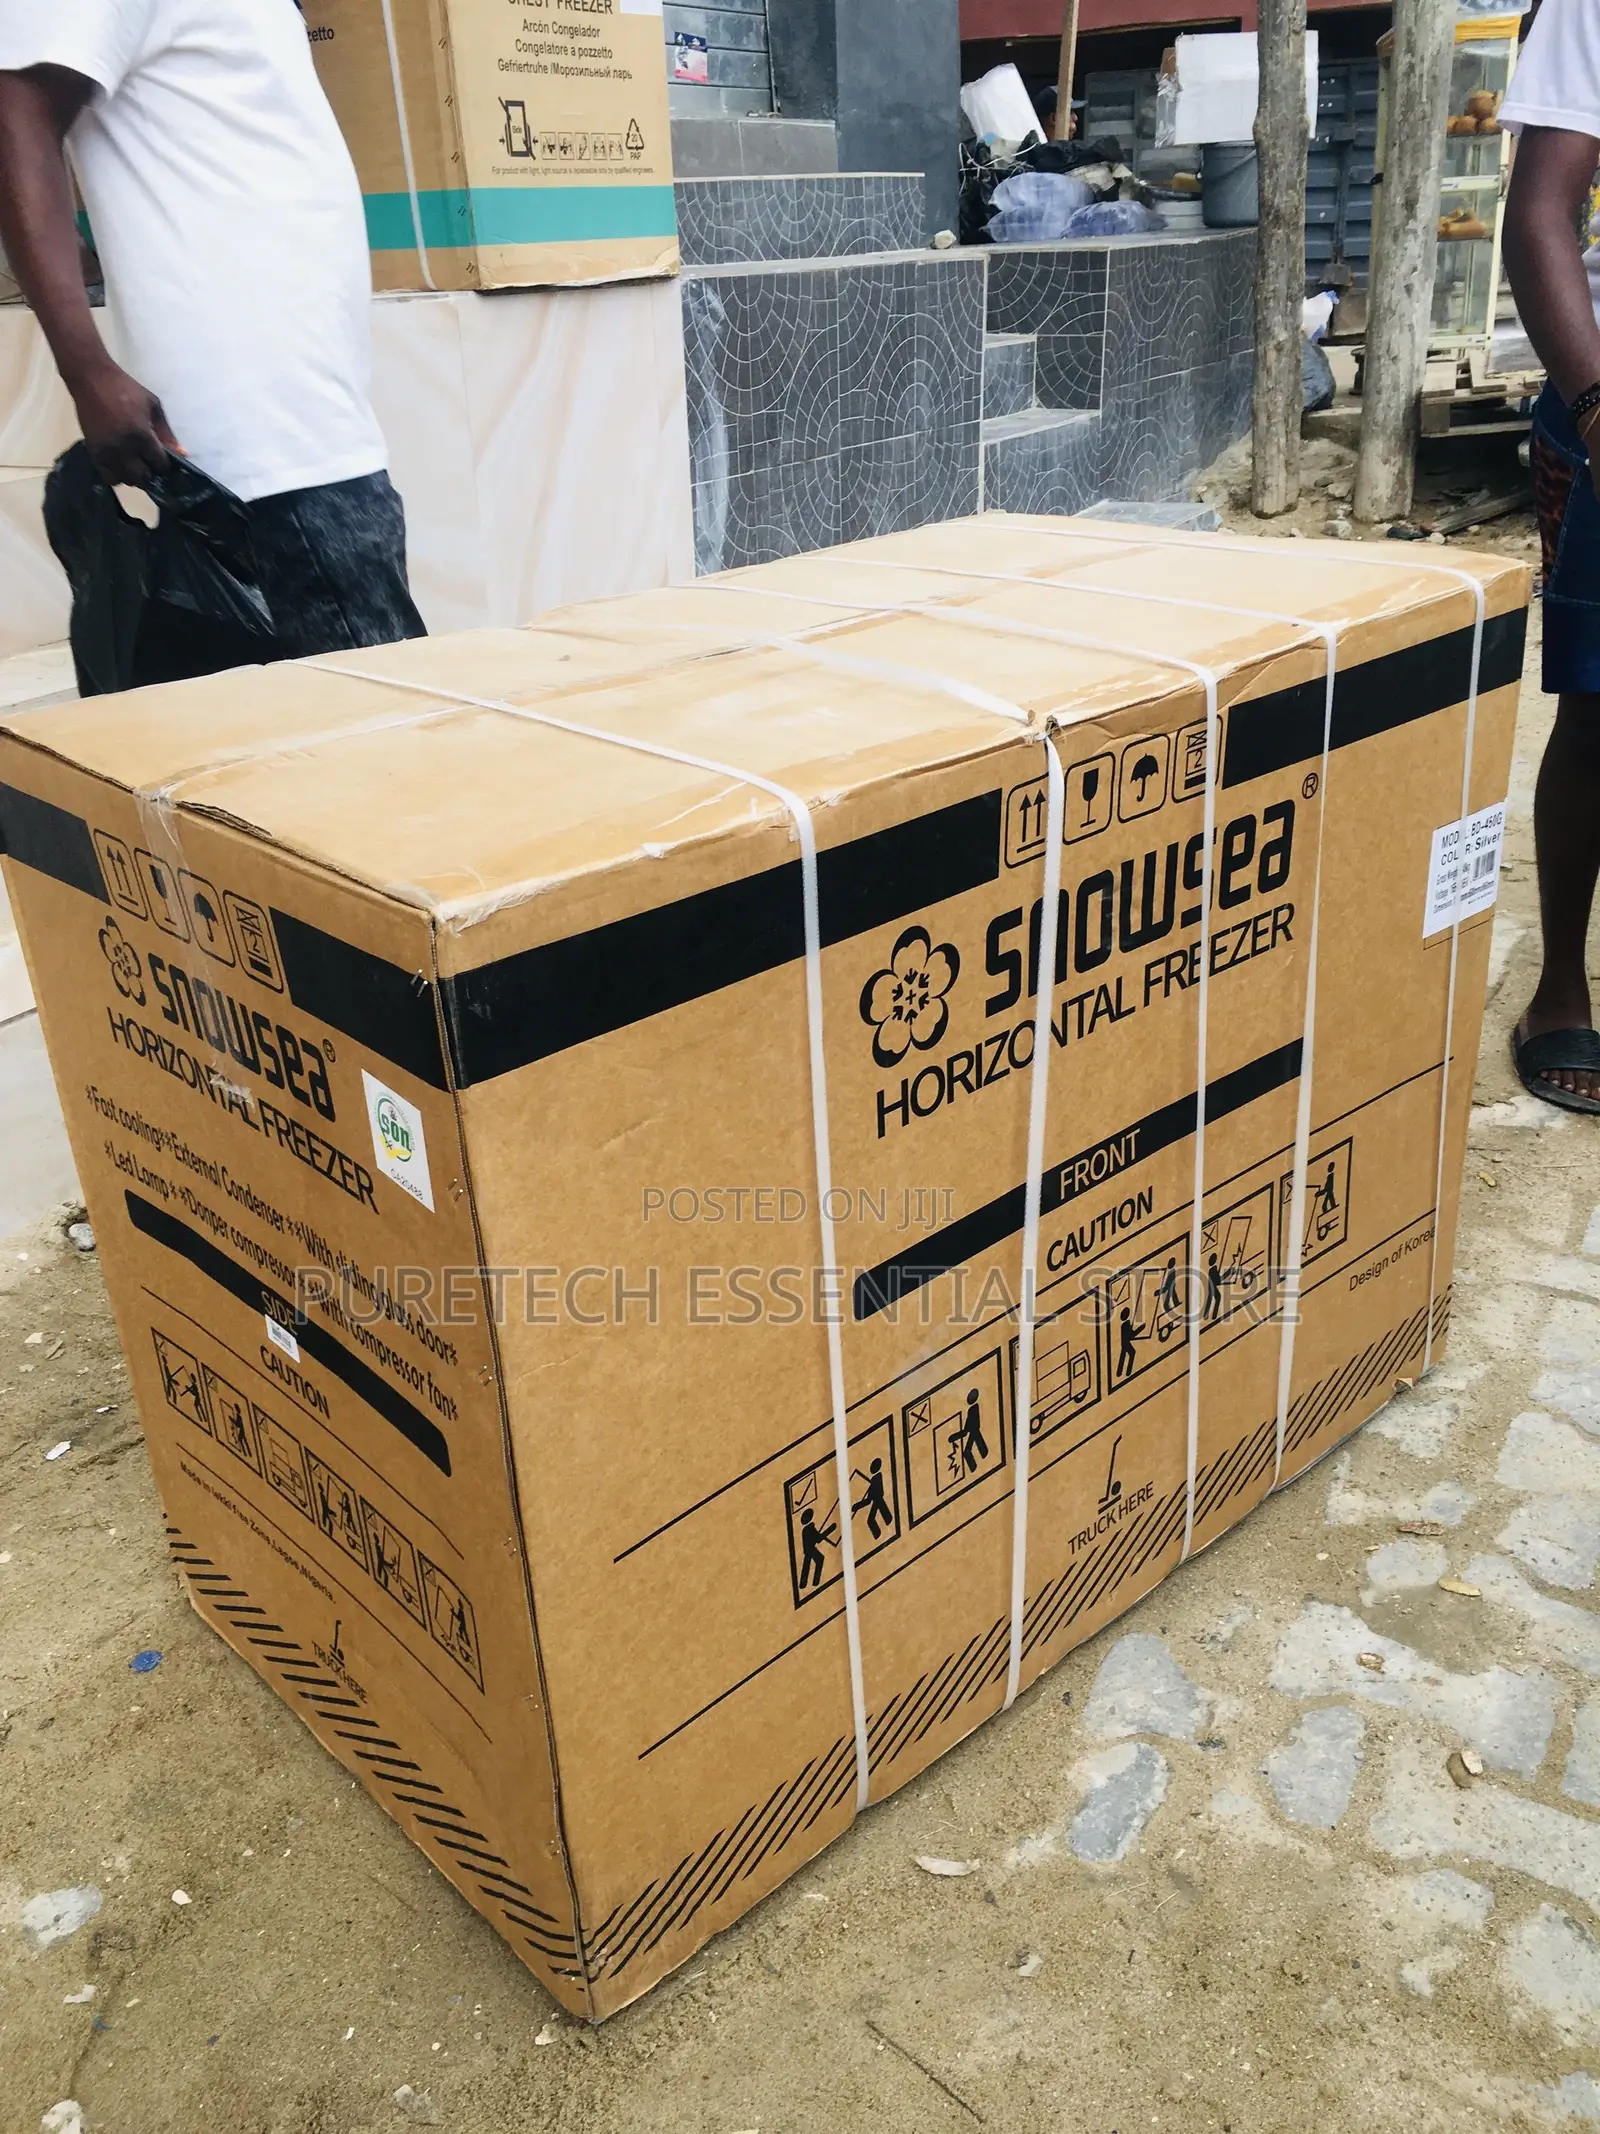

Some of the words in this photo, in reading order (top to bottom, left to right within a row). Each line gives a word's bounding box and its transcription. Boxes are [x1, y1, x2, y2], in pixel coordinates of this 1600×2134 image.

[515, 39, 569, 57] Congelatore
[571, 48, 576, 56] a
[578, 46, 613, 60] pozzetto
[522, 19, 550, 34] Arcón
[551, 21, 601, 39] Congelador
[498, 58, 549, 75] Gefriertruhe
[1441, 843, 1473, 866] COLR:
[1475, 832, 1501, 851] Silver
[877, 976, 1135, 1138] HORIZONTAL
[1143, 902, 1295, 1008] FREEZER
[107, 1006, 260, 1131] HORIZONTAL
[258, 1098, 379, 1215] FREEZER
[1060, 1128, 1141, 1200] FRONT
[221, 1165, 286, 1235] Condenser
[1046, 1185, 1153, 1272] CAUTION
[1349, 1256, 1389, 1292] Design
[1391, 1243, 1404, 1264] of
[1404, 1226, 1436, 1255] Korea
[261, 1290, 298, 1336] SIDE
[260, 1344, 330, 1420] CAUTION
[350, 1317, 425, 1396] compressor
[1067, 1510, 1117, 1557] TRUCK
[1118, 1480, 1155, 1522] HERE
[312, 1640, 341, 1680] TRUCK
[343, 1672, 368, 1704] HERE
